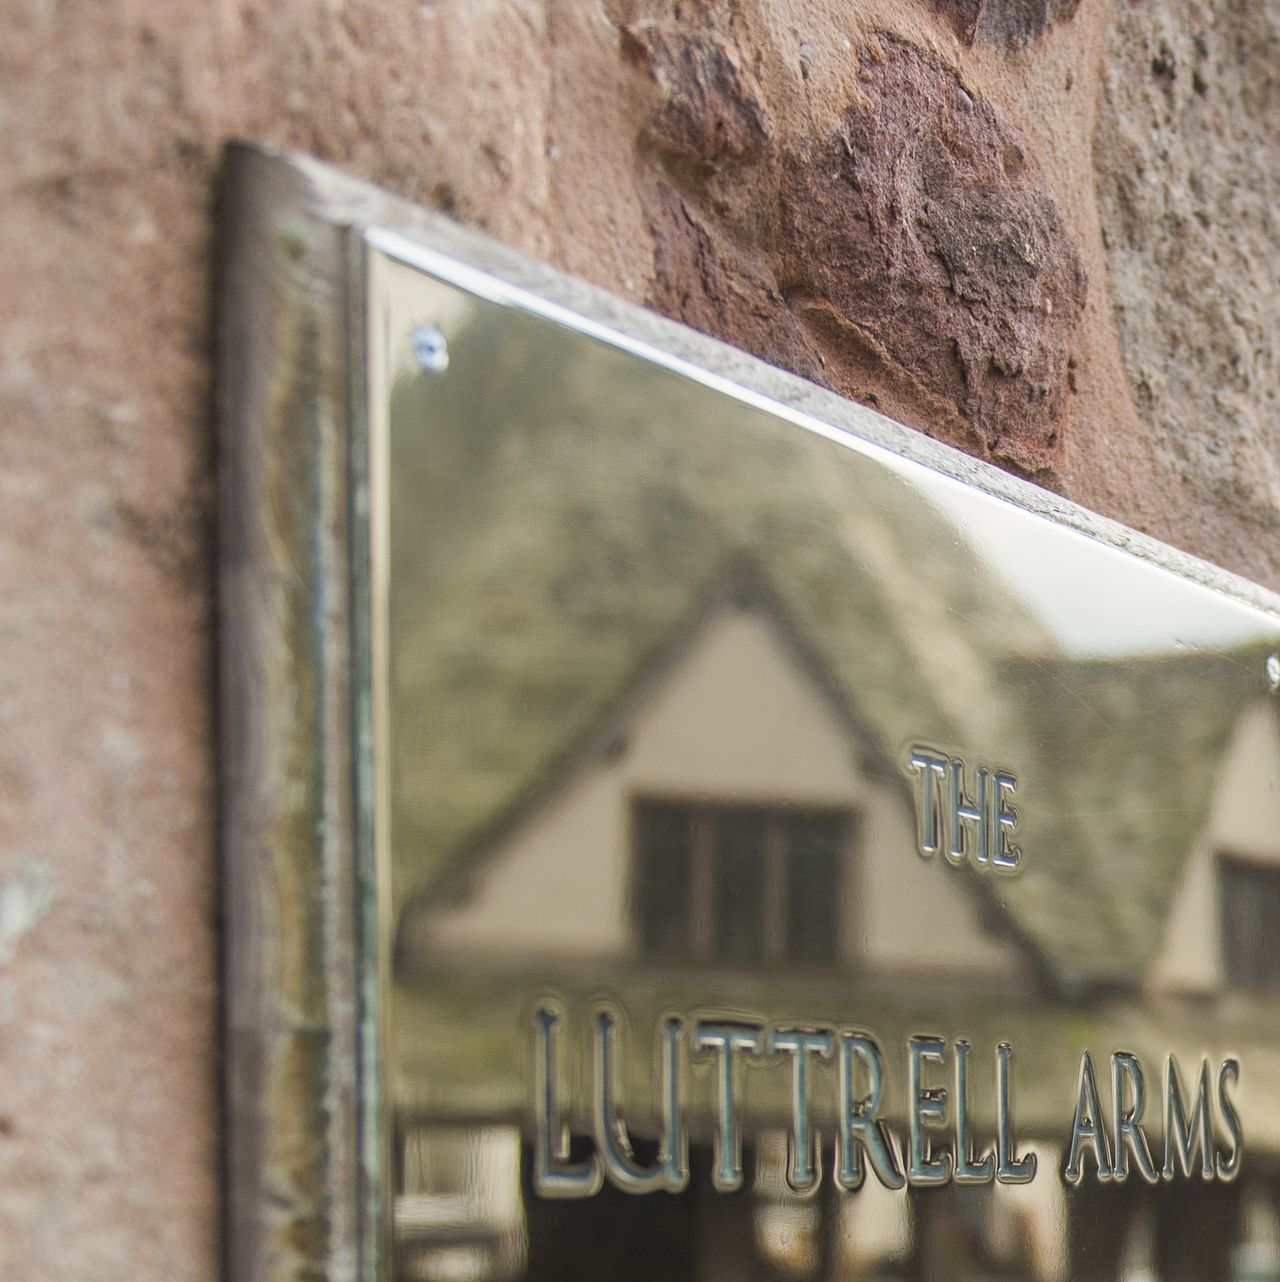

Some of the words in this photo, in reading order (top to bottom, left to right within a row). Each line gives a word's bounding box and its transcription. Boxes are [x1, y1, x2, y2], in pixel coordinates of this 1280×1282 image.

[907, 746, 1022, 868] THE
[534, 1006, 1037, 1196] LUTTRELL
[1064, 1048, 1244, 1184] ARMS
